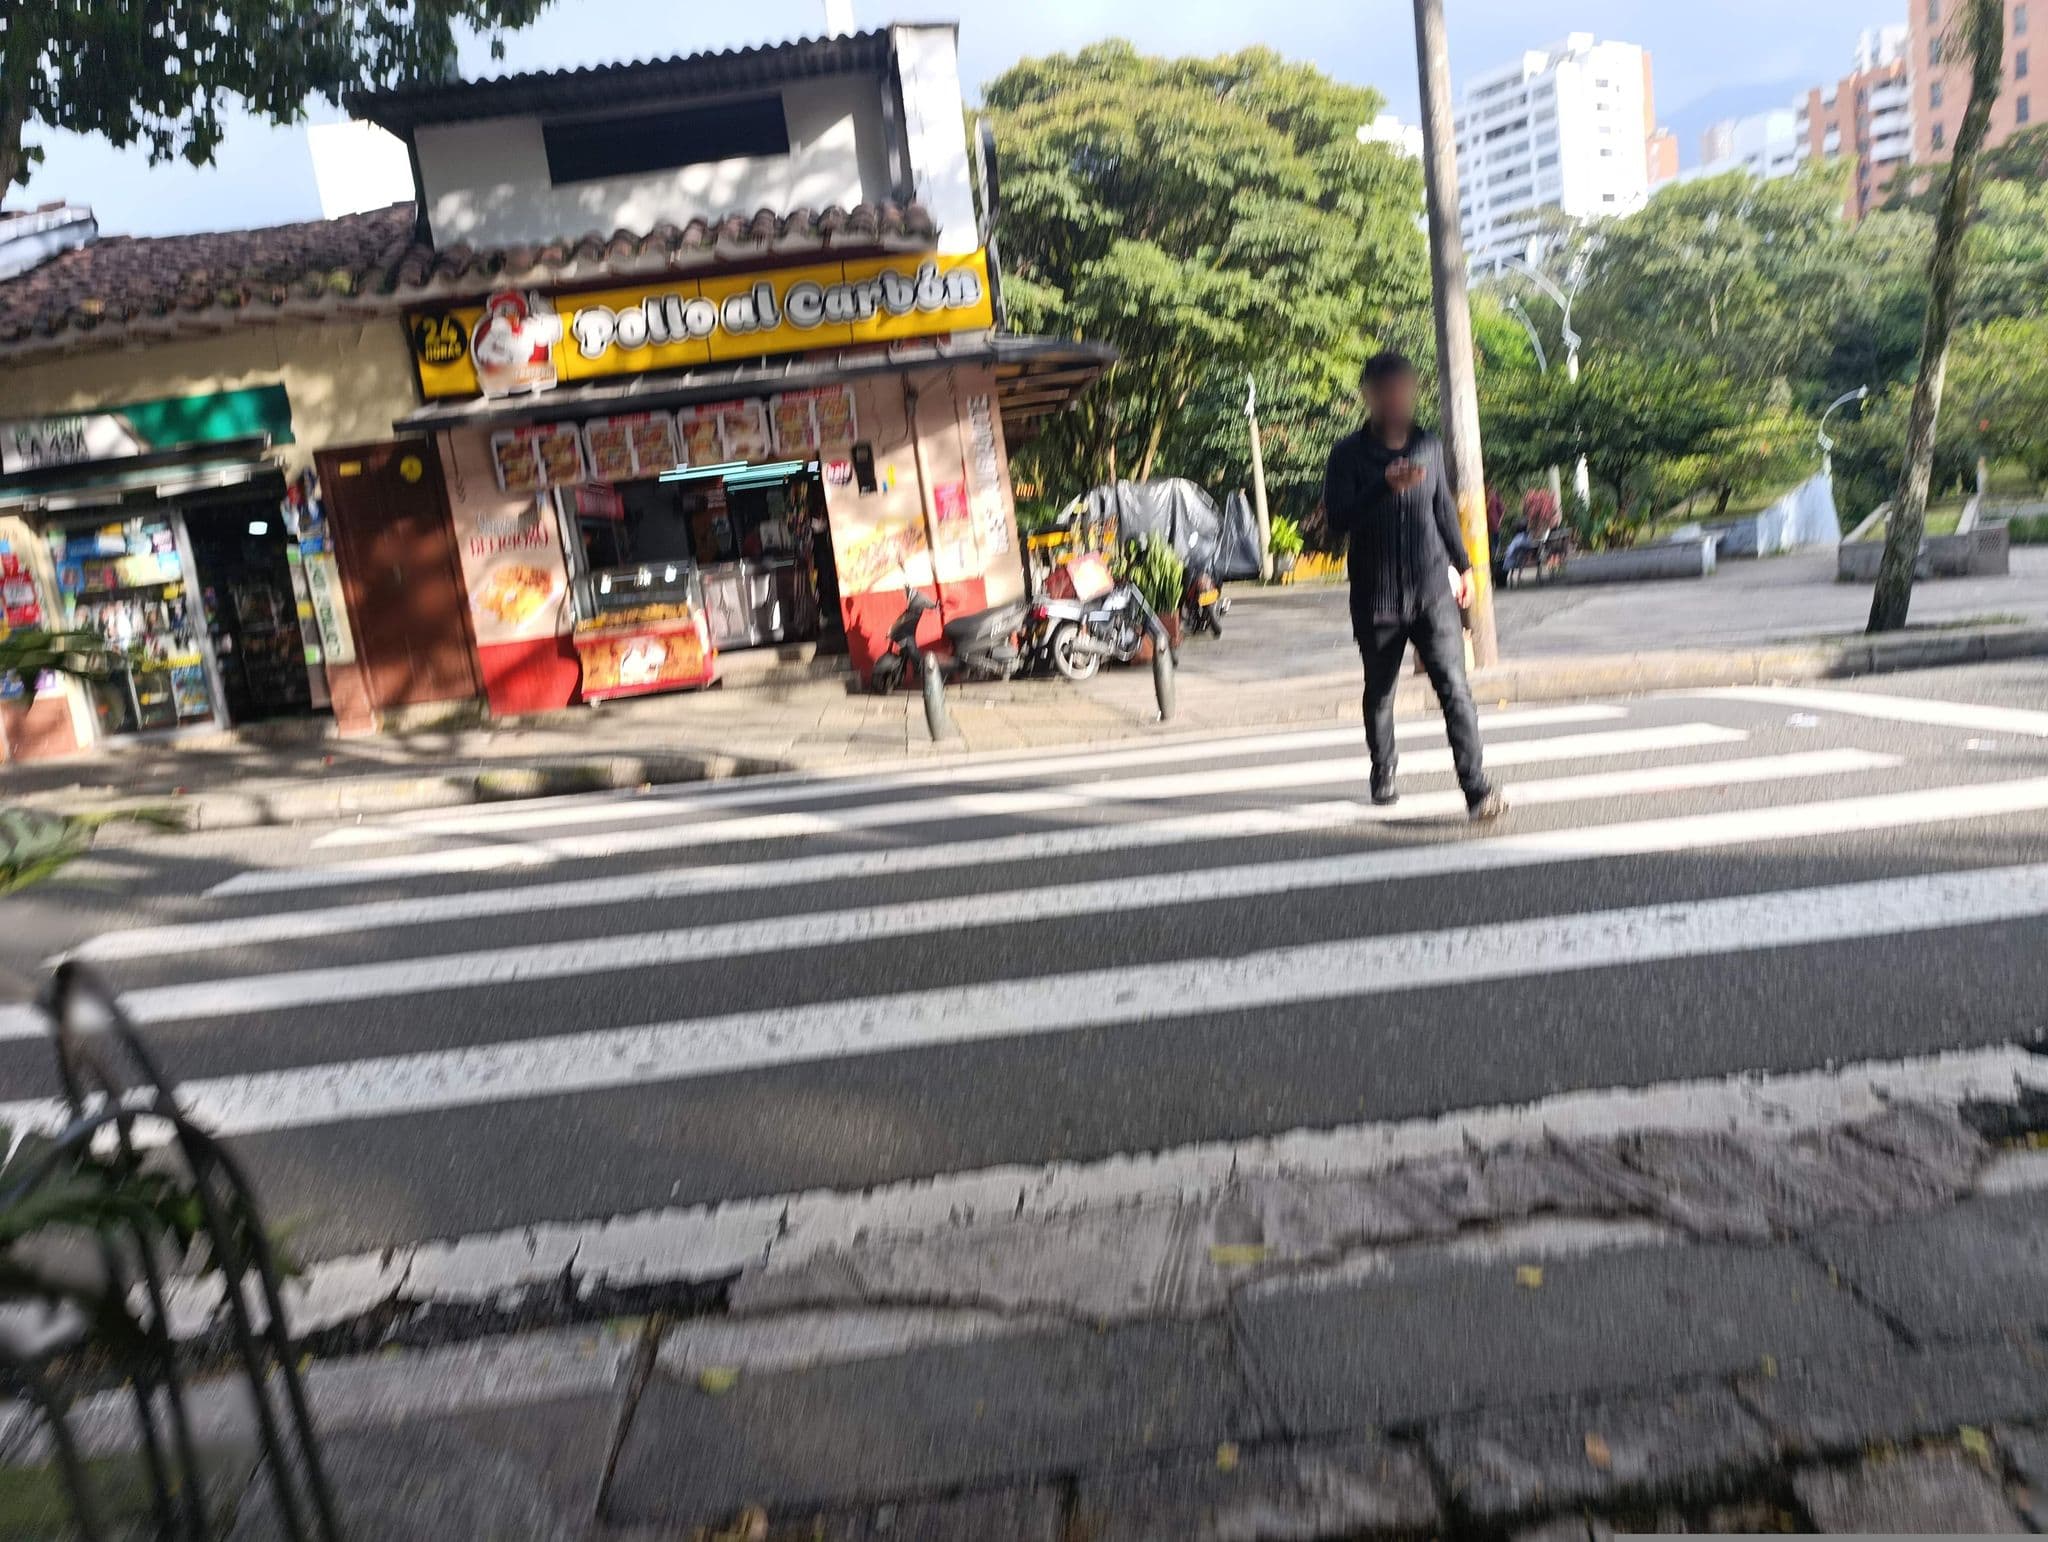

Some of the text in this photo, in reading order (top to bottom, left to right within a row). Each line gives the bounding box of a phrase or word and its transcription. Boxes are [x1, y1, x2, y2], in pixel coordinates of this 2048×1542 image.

[422, 314, 459, 343] 24
[575, 263, 980, 358] Pollo al Carbón
